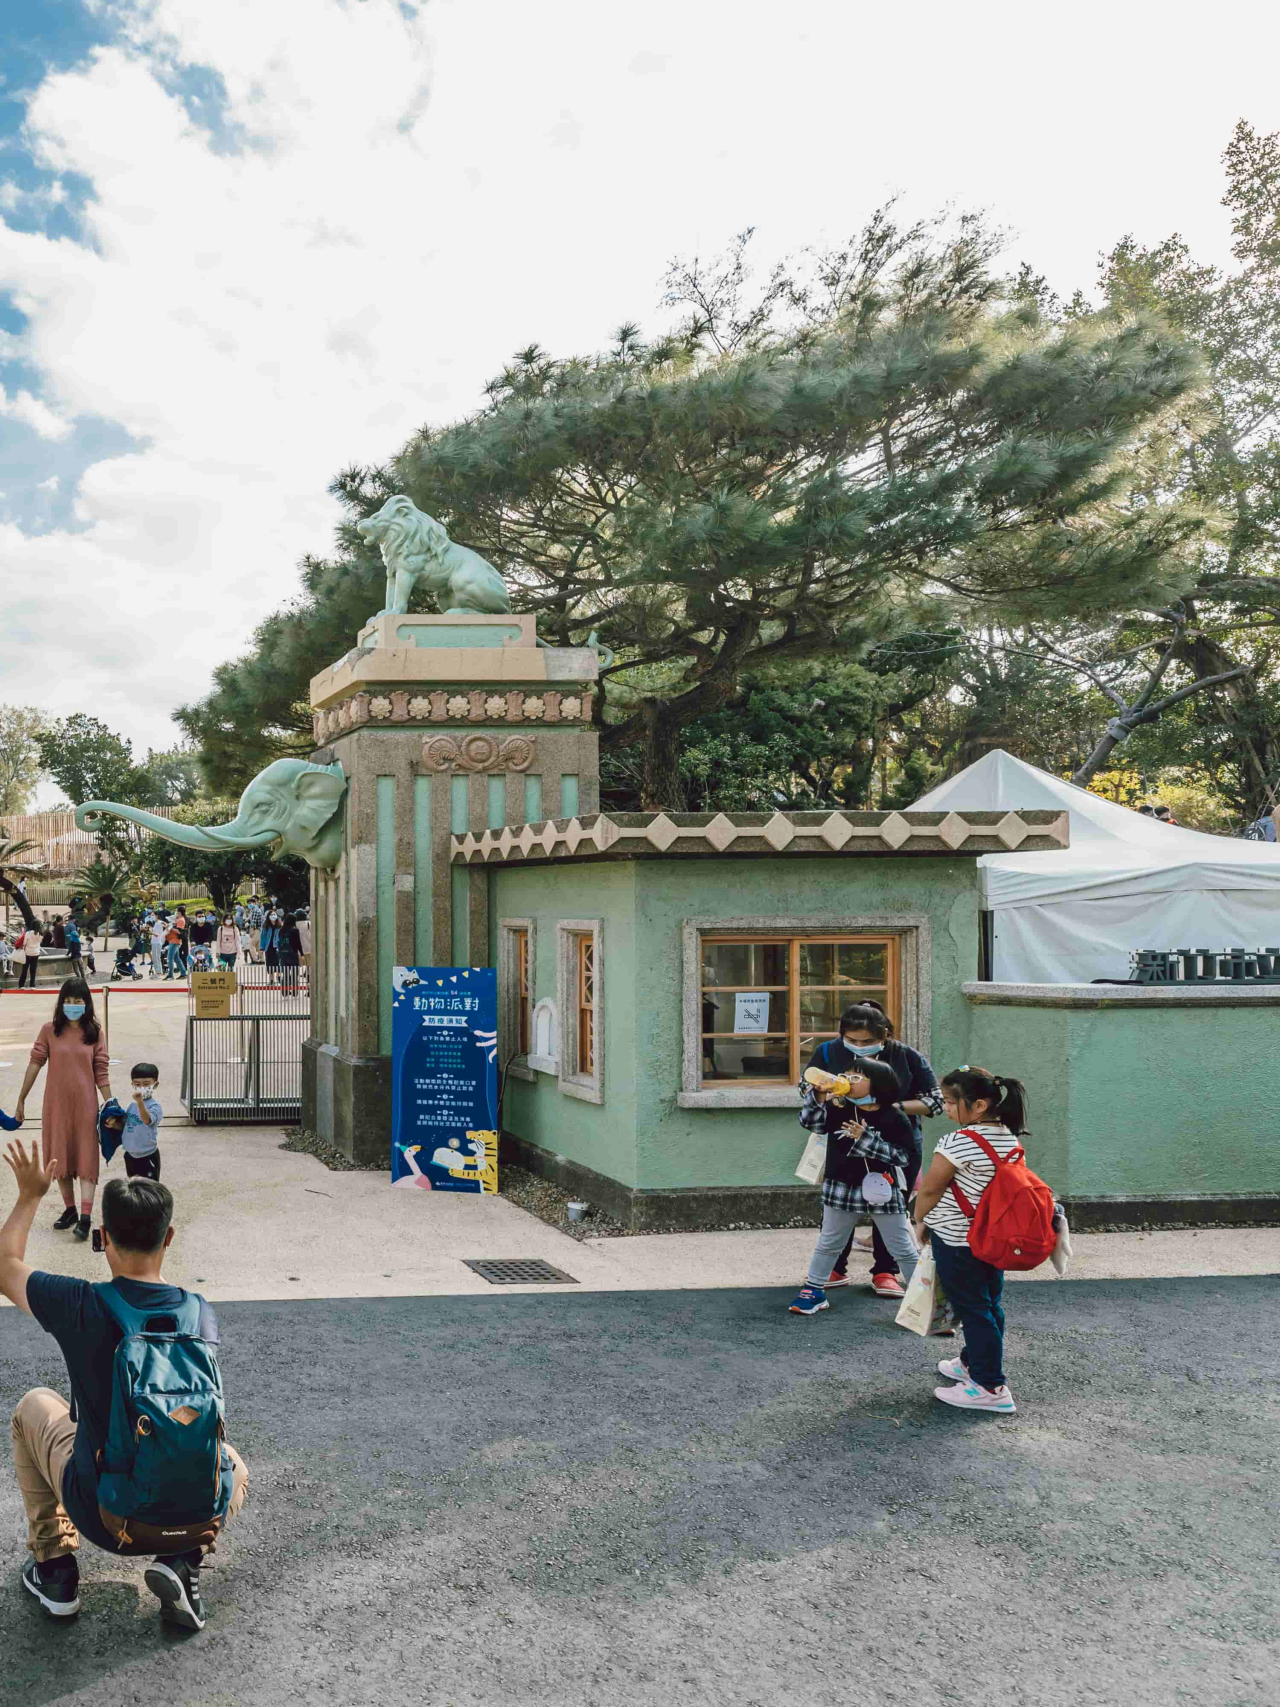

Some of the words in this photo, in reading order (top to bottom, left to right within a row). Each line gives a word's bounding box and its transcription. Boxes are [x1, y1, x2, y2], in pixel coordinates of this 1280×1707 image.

[413, 996, 480, 1011] 動物派對
[428, 1017, 463, 1025] 防疫須知
